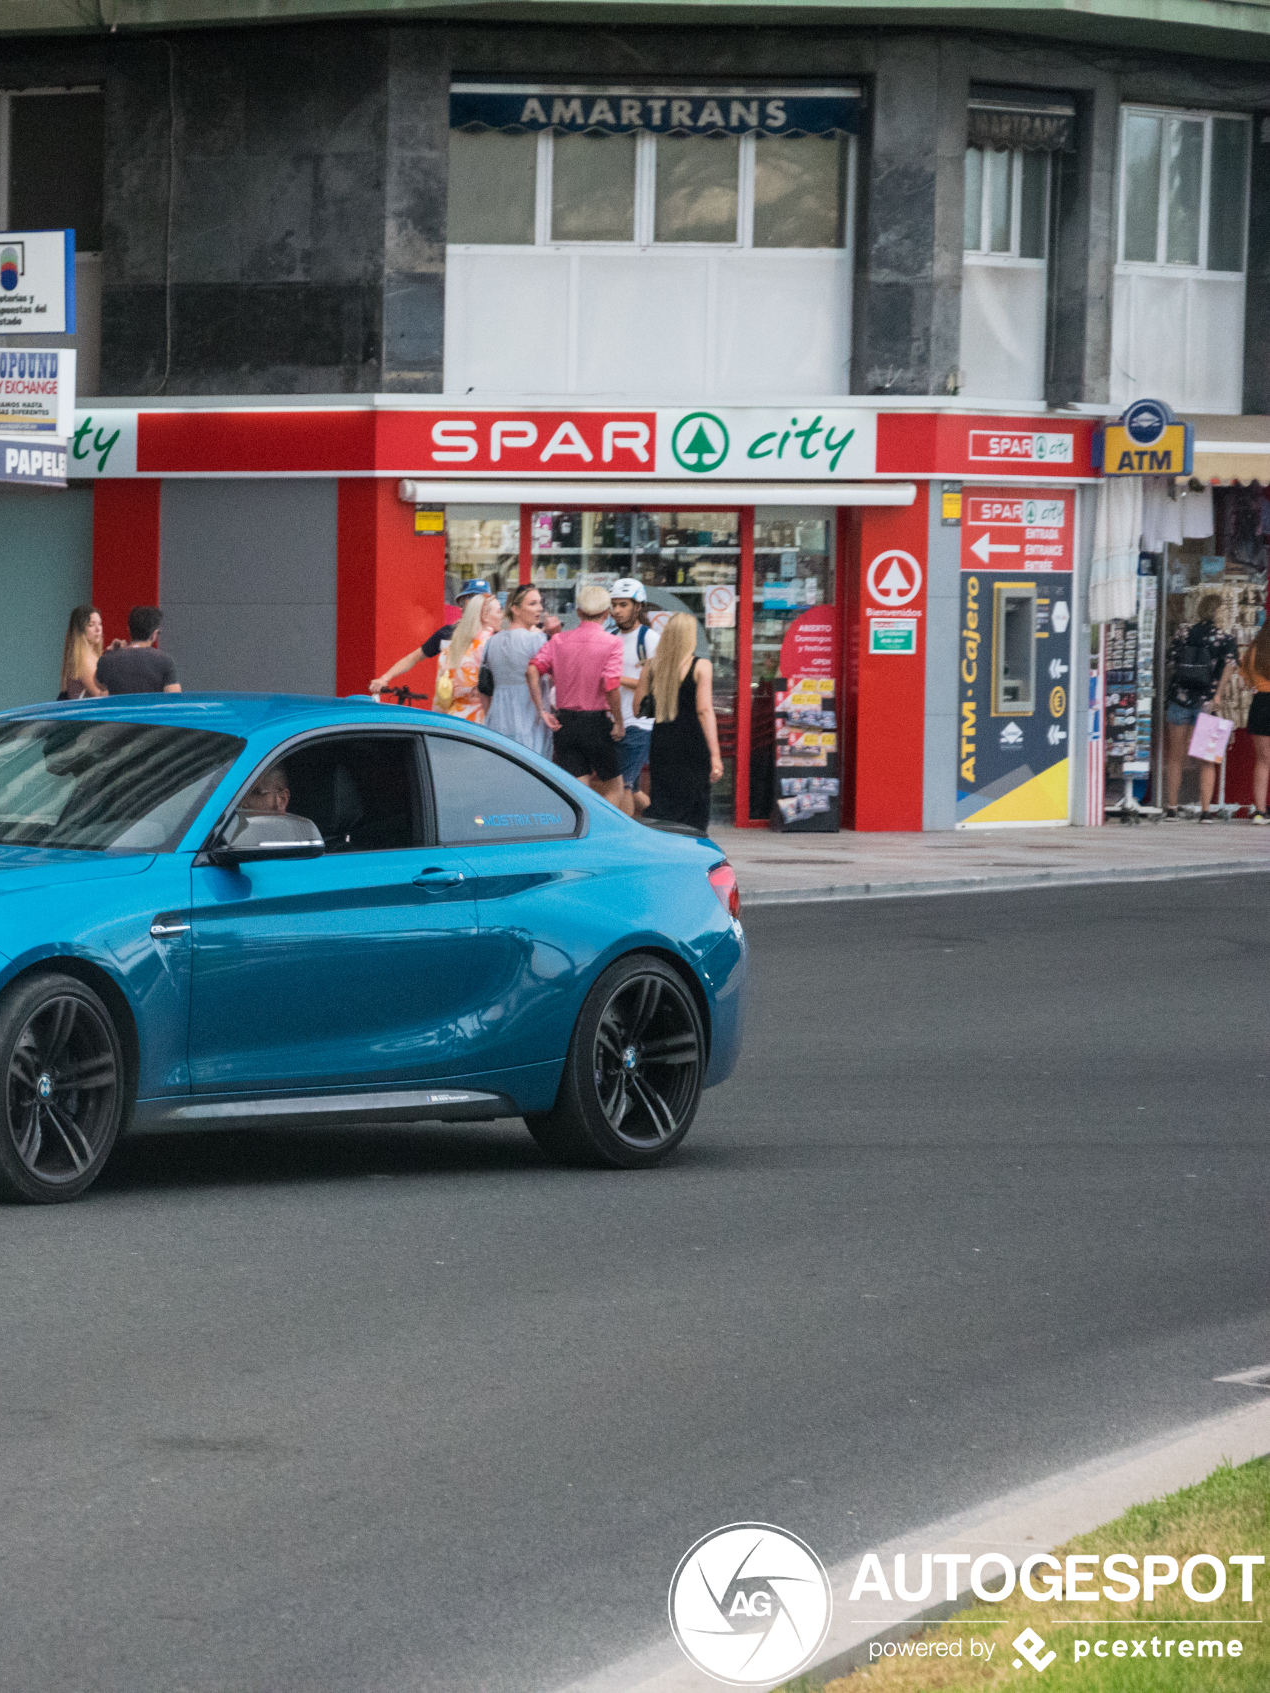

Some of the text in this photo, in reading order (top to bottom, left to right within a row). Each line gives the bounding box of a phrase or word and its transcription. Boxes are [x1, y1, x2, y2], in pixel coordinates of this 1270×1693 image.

[520, 98, 788, 127] AMARTRANS
[34, 303, 47, 313] del
[5, 380, 58, 395] EXCHANGE
[431, 414, 856, 473] SPAR city
[989, 437, 1070, 456] SPAR city
[1117, 450, 1172, 472] ATM
[981, 501, 1064, 520] SPAR city
[1025, 527, 1059, 540] ENTRADA
[1024, 544, 1064, 556] ENTRANCE
[1024, 559, 1054, 571] ENTRÉE
[866, 607, 923, 617] Bienvenidos
[798, 624, 832, 633] ABIERTO
[794, 635, 832, 644] Domingos
[811, 658, 832, 666] OPEN
[960, 576, 982, 783] ATM Cajero
[531, 813, 562, 825] TEAM
